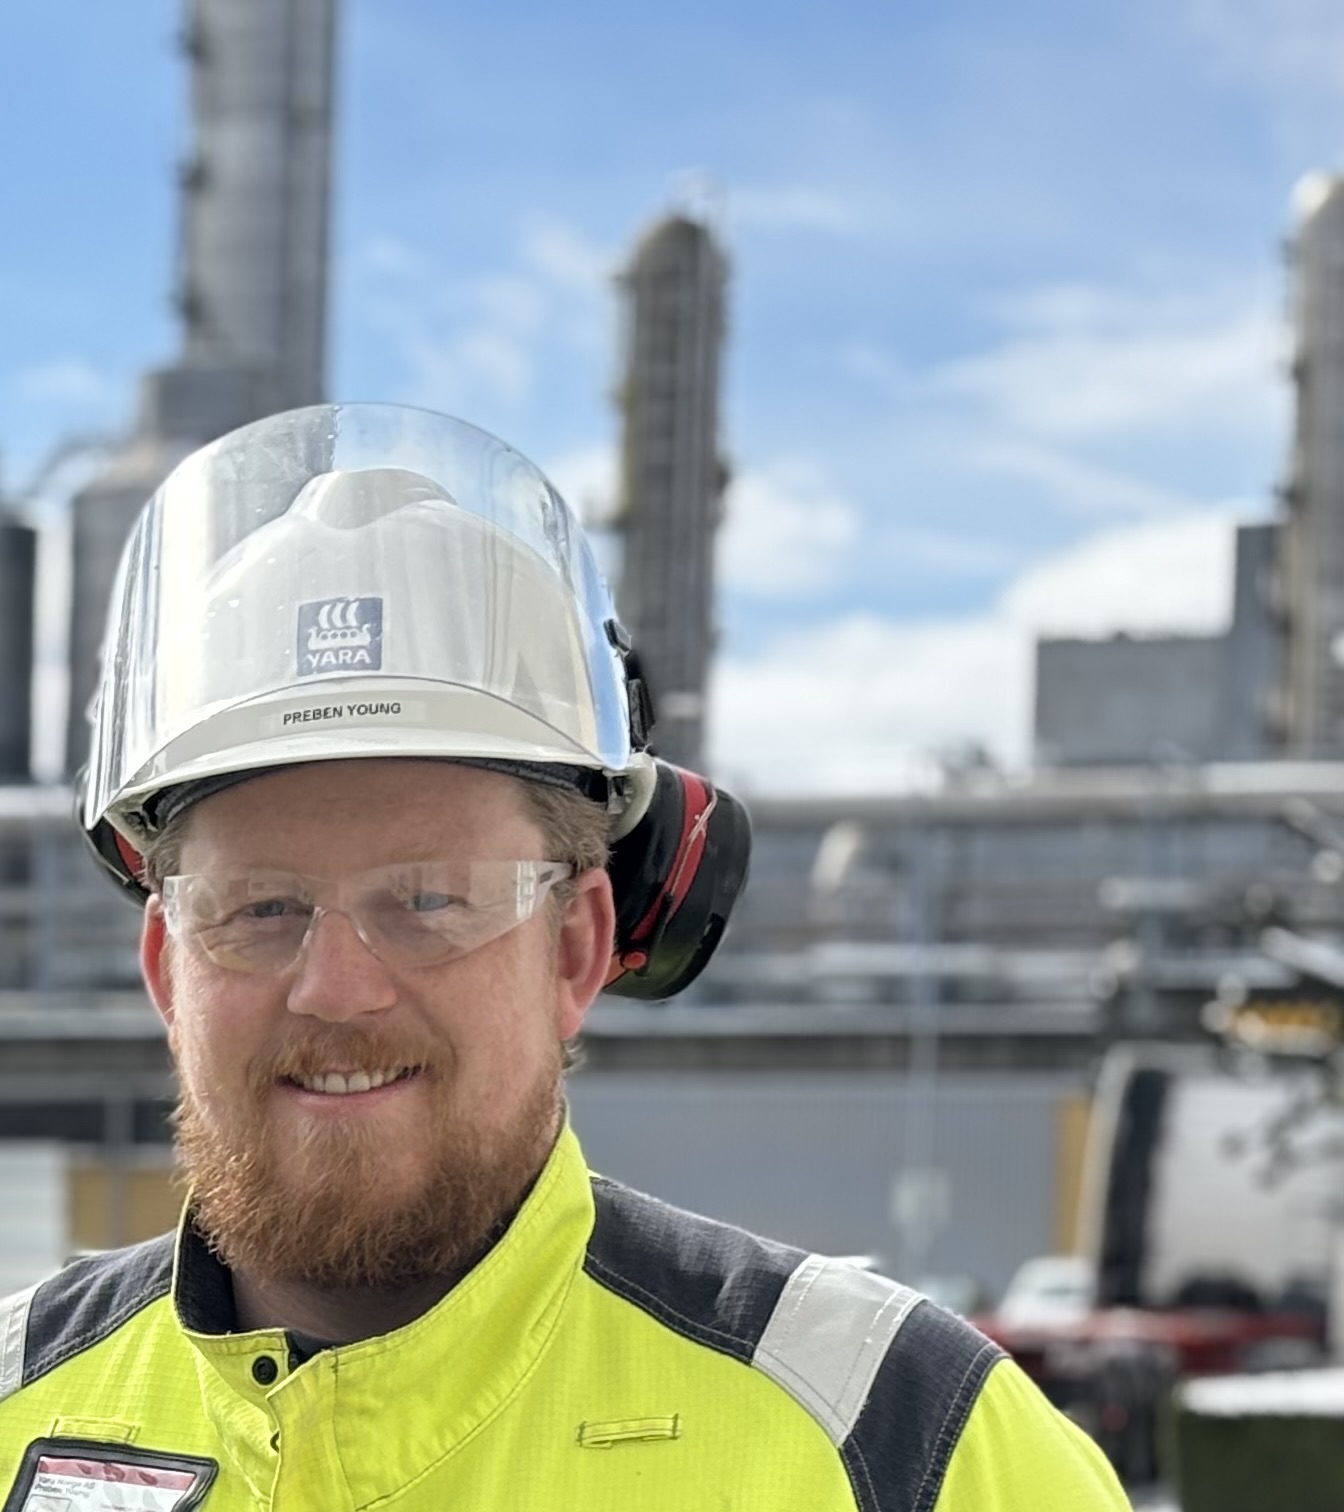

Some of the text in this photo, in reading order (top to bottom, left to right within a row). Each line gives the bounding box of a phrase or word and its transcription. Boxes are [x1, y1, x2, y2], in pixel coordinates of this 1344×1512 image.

[306, 648, 372, 668] YARA
[282, 702, 402, 725] PREBEN YOUNG
